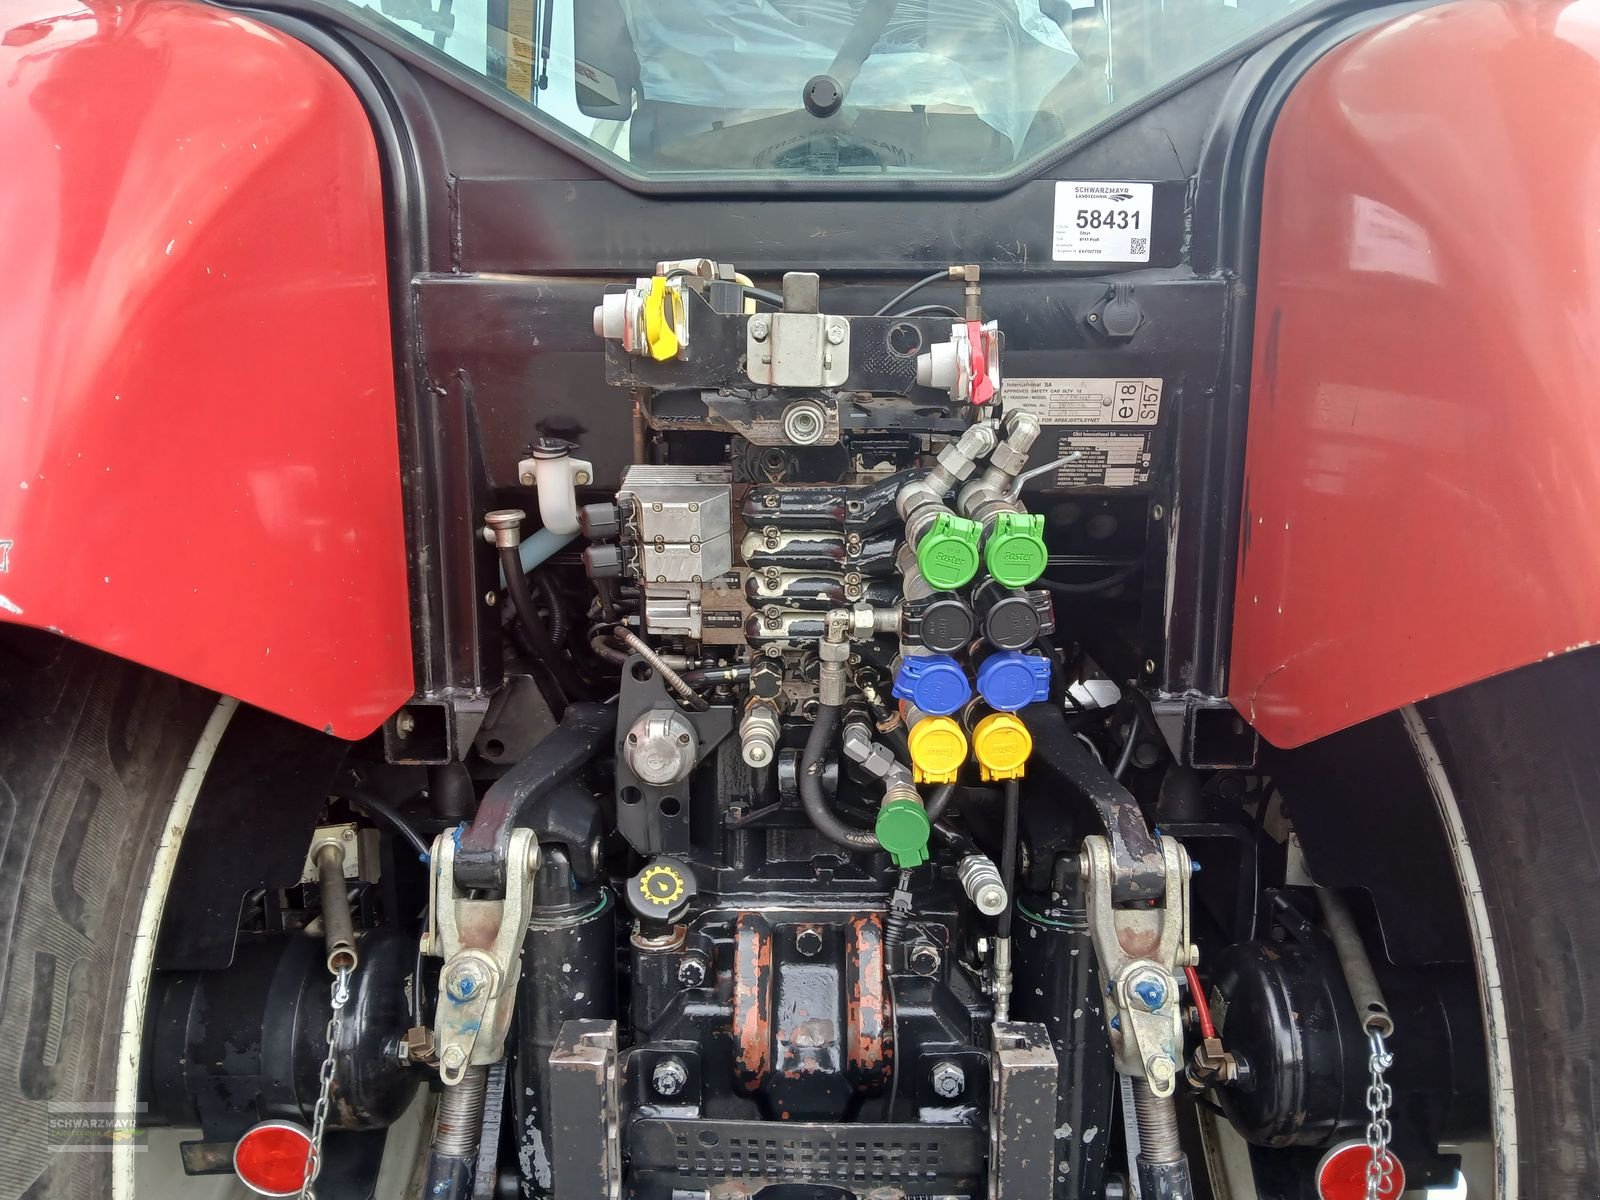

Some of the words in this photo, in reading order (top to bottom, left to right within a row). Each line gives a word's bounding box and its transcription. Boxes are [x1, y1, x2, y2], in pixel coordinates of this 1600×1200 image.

[1074, 186, 1129, 194] SCHWARZMAYR
[1076, 209, 1140, 230] 58431
[1118, 385, 1136, 418] e18
[1140, 384, 1159, 419] S157
